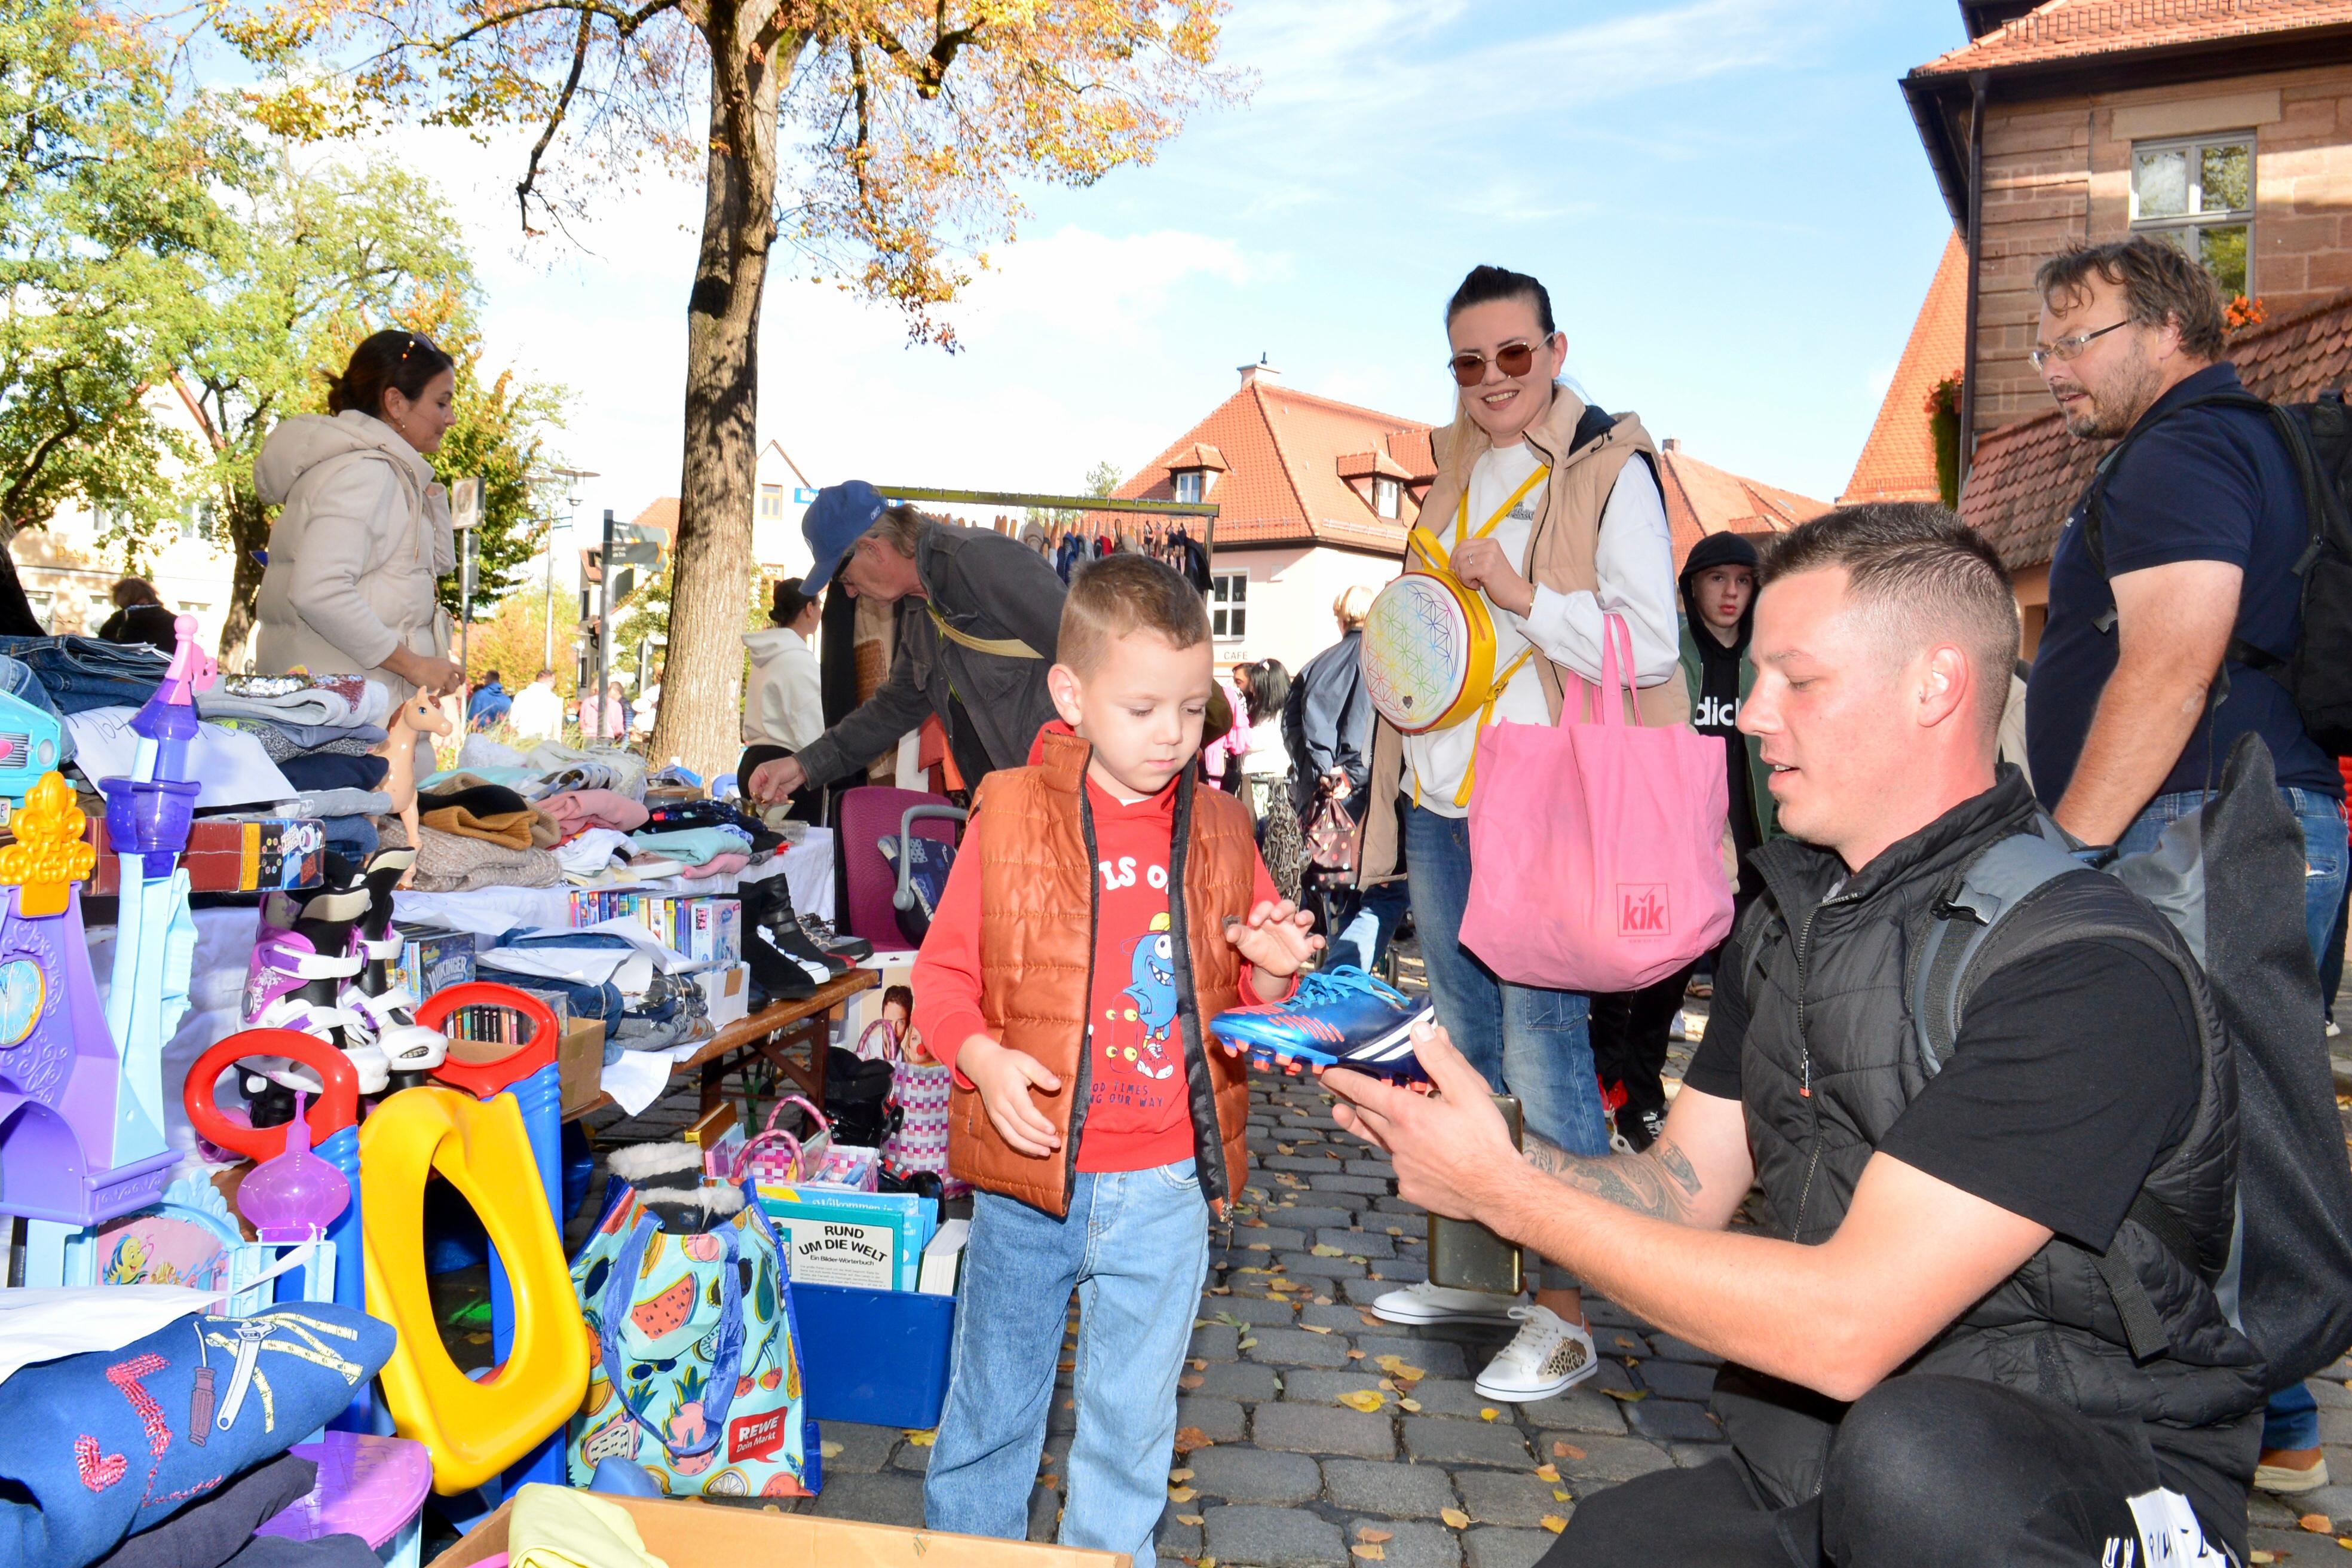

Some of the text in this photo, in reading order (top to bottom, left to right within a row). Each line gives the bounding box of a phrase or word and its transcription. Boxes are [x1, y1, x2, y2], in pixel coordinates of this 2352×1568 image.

[1224, 651, 1248, 660] CAFE
[1622, 887, 1664, 930] kik
[426, 956, 467, 996] WIKINGER
[1114, 1080, 1148, 1095] TIMES
[1110, 1094, 1131, 1105] OUR
[1140, 1097, 1162, 1107] WAY
[824, 1225, 865, 1239] RUND
[798, 1239, 888, 1263] UM DIE WELT
[820, 1256, 875, 1266] Bilder-Wörterbuch
[739, 1415, 780, 1442] REWE
[736, 1431, 776, 1453] Dein Markt
